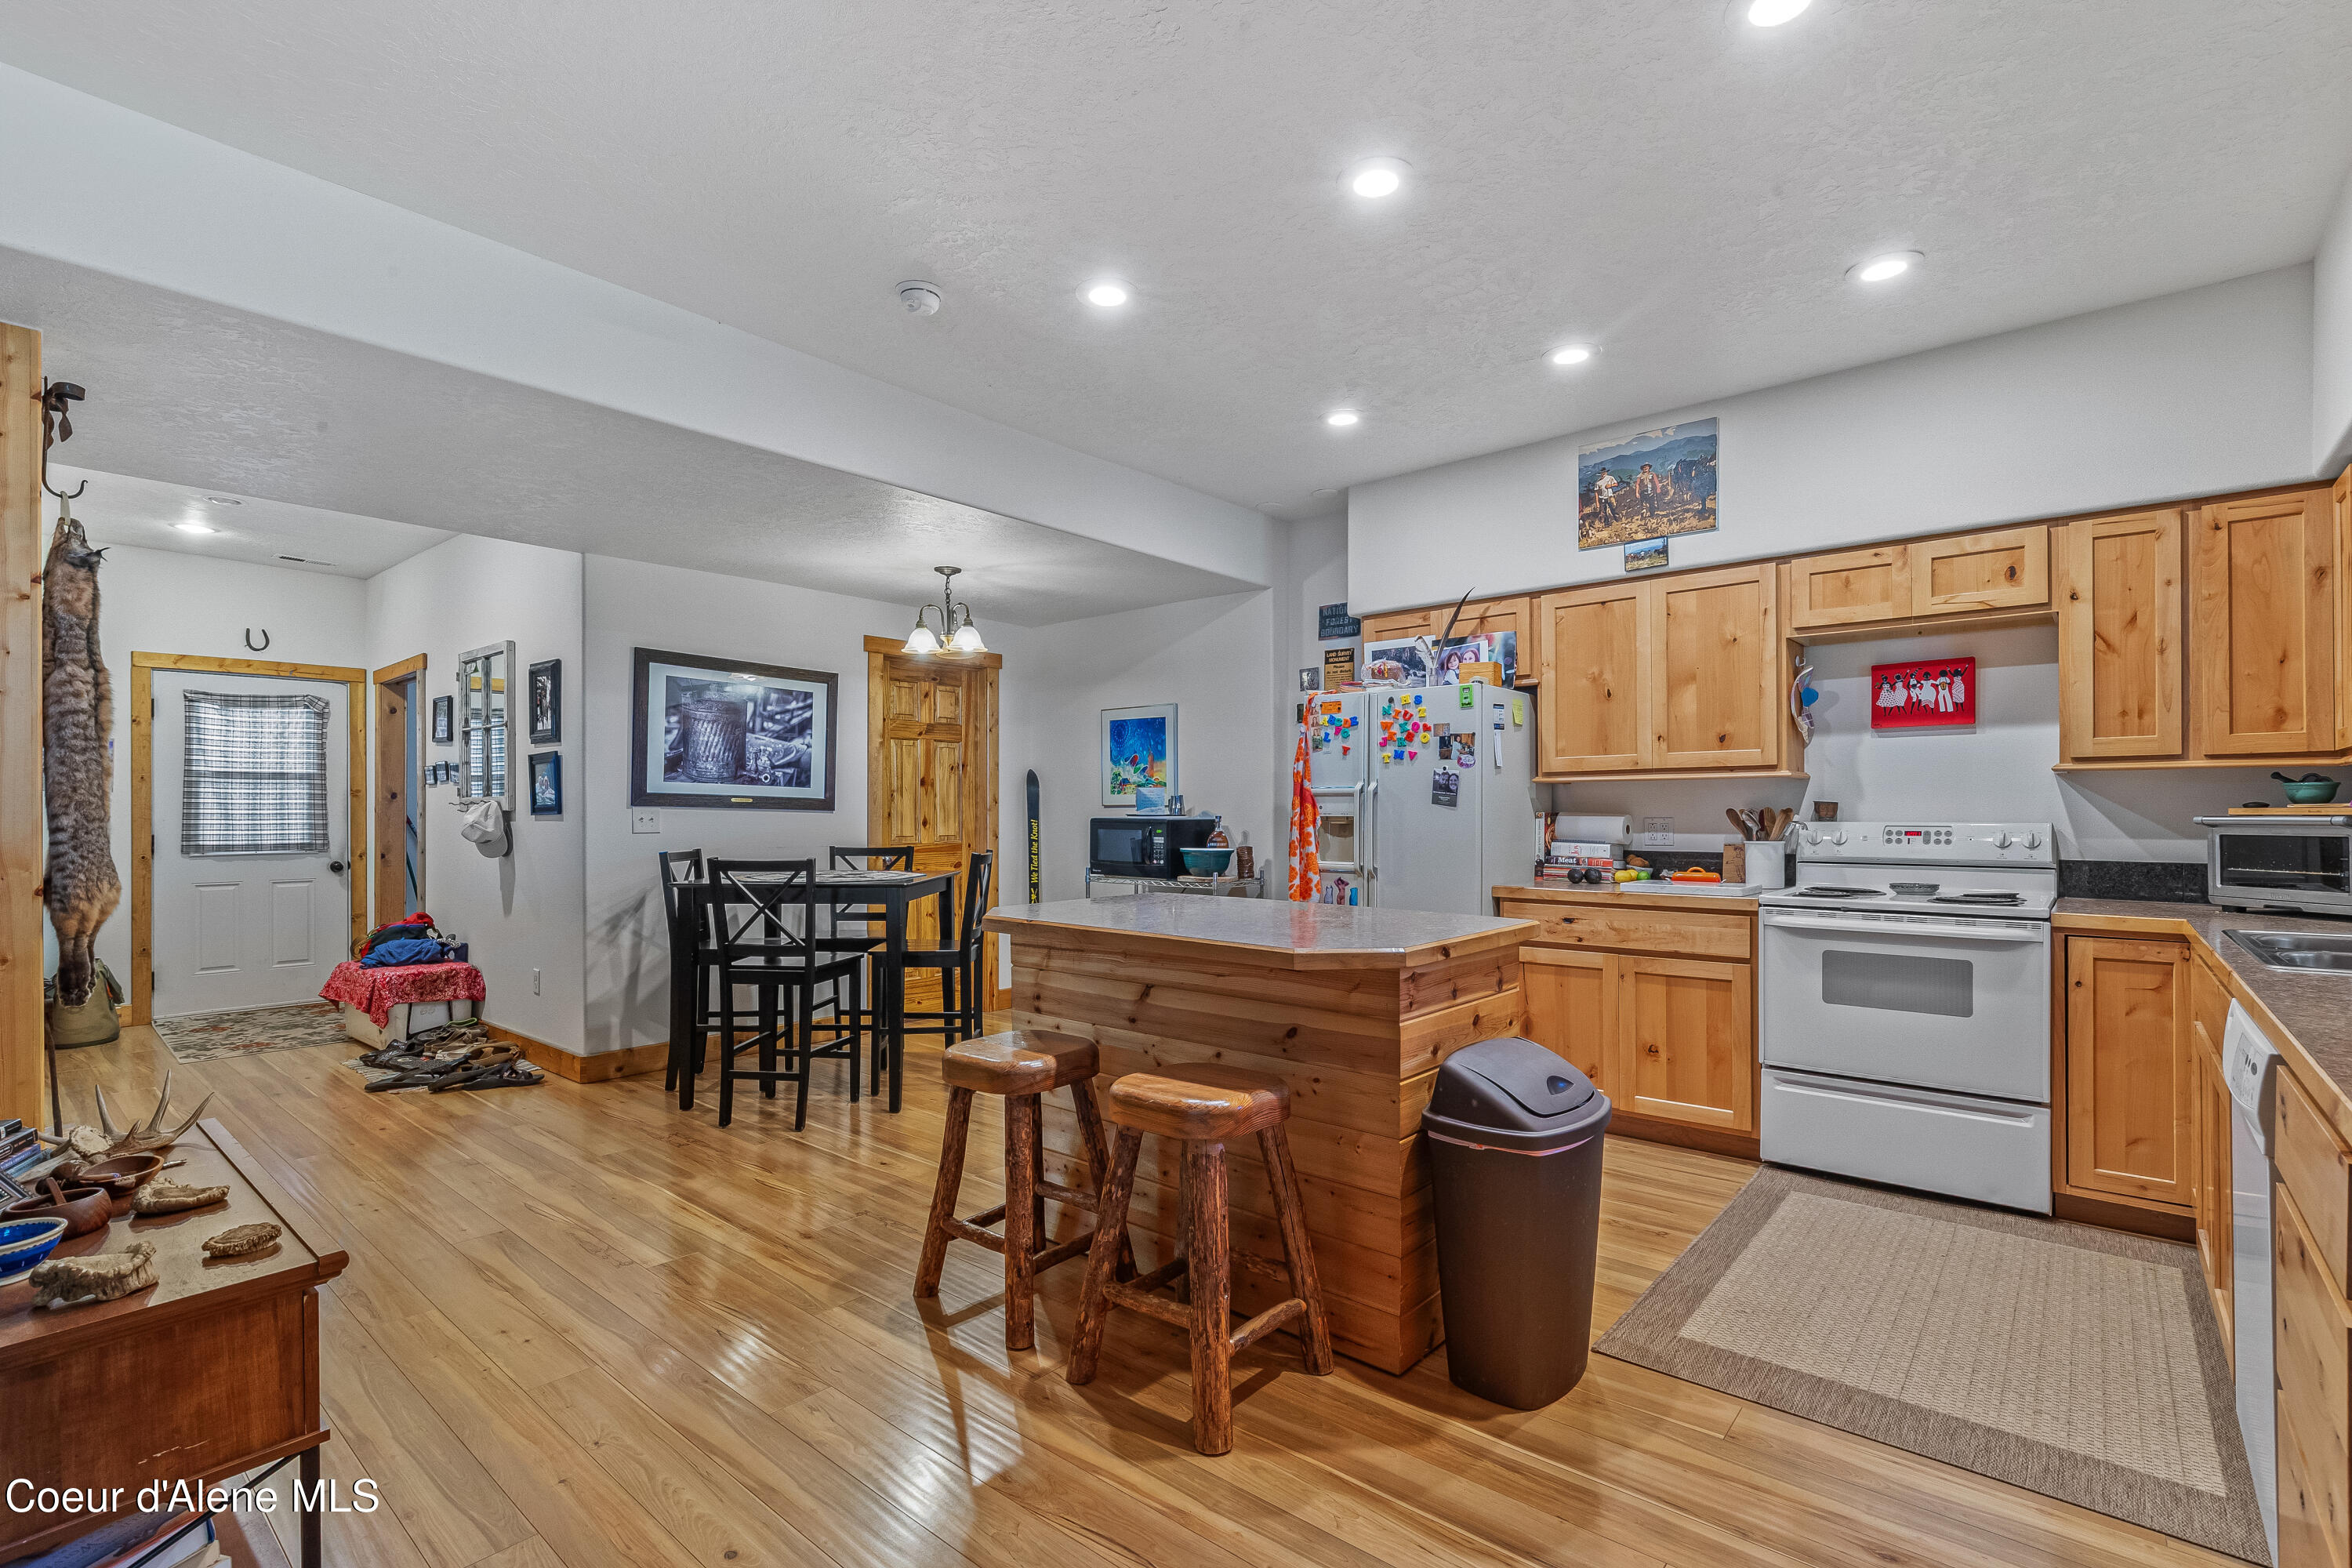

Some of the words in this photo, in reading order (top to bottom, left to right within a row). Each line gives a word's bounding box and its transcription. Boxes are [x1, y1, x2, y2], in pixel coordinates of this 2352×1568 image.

[1320, 625, 1358, 637] BOUNDARY
[1414, 695, 1422, 705] S
[1382, 704, 1392, 716] N
[1417, 707, 1426, 717] Z
[1381, 721, 1394, 731] W
[1030, 872, 1039, 883] We
